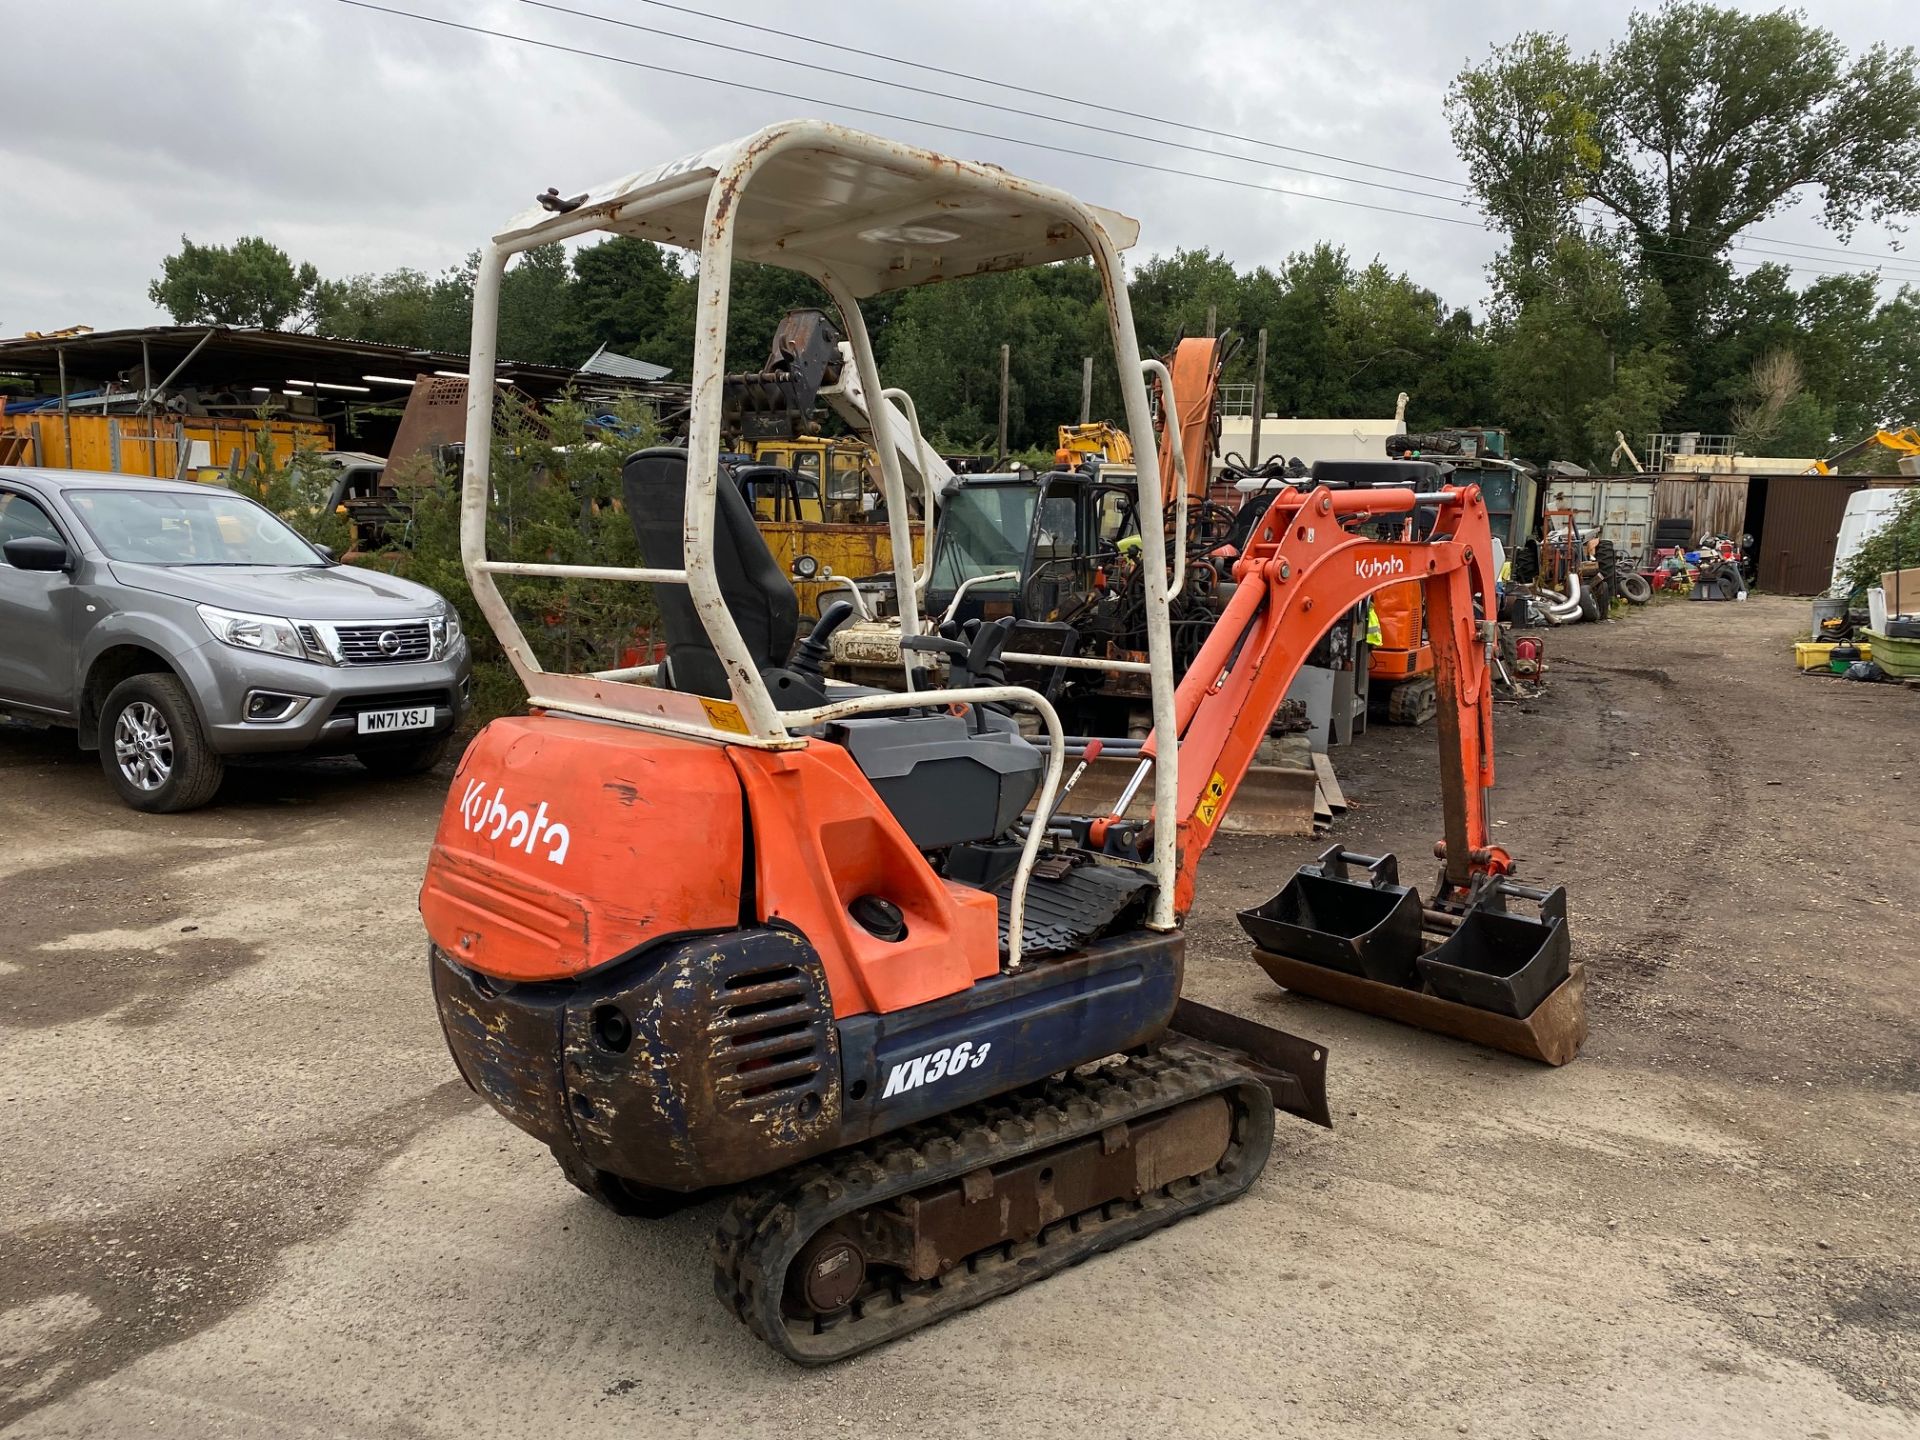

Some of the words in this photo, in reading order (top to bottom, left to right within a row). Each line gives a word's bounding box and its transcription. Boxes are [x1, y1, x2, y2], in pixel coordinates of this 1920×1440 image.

[1355, 555, 1404, 579] Kubota
[367, 712, 398, 730] WN71
[401, 709, 427, 727] XSJ
[459, 778, 570, 865] Kubota
[881, 1041, 992, 1100] KX36-3
